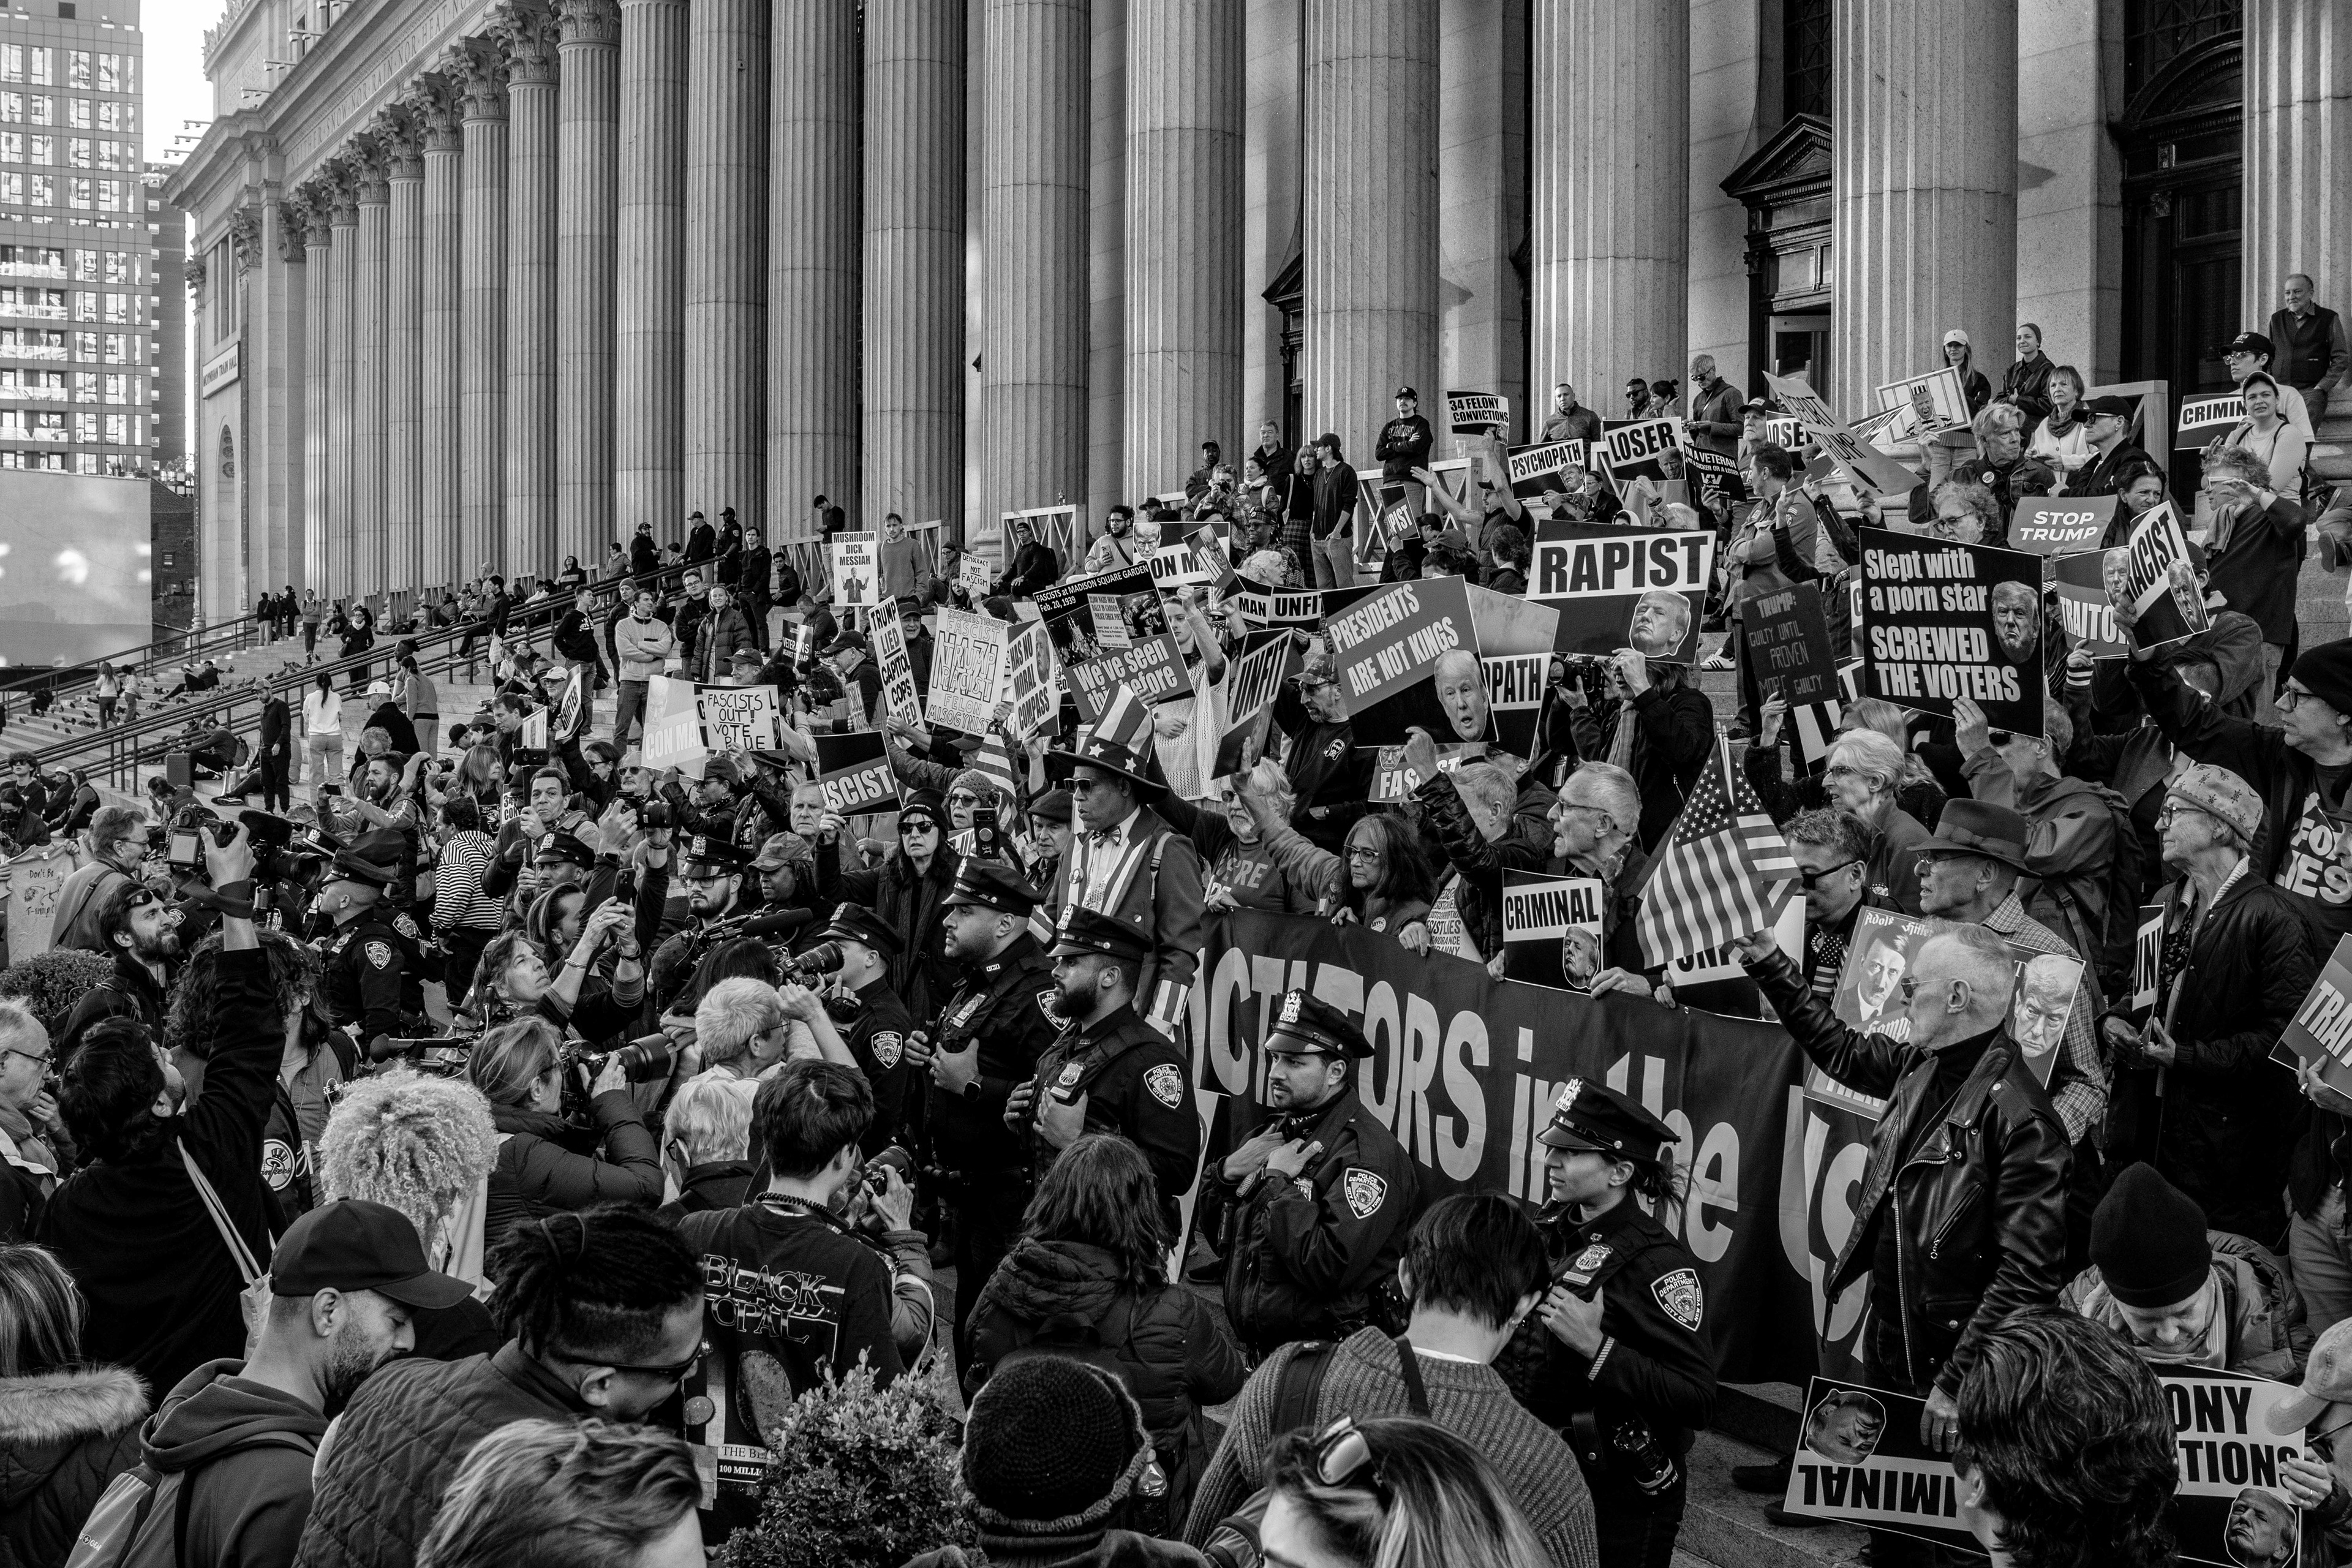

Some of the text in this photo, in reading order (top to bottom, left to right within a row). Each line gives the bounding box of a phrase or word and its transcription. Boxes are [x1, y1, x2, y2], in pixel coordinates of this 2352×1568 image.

[422, 4, 447, 45] HEAT
[1449, 397, 1499, 411] 34 FELONY
[2182, 401, 2248, 425] CRIMIN
[1453, 410, 1509, 423] CONVICTIONS
[1608, 422, 1676, 462] LOSER
[1768, 421, 1807, 448] LOSE
[1809, 431, 1866, 465] TRUMP
[1512, 442, 1582, 478] PSYCHOPATH
[1696, 462, 1712, 471] SUCKER
[1725, 467, 1739, 476] LOSER
[1699, 452, 1736, 469] VETERAN
[2032, 511, 2095, 526] STOP
[833, 532, 875, 543] MUSHROOM
[2019, 526, 2098, 541] TRUMP
[839, 555, 871, 566] MESSIAH
[846, 544, 863, 554] DICK
[962, 554, 989, 567] DEMOCRACY
[1539, 536, 1708, 595] RAPIST
[1865, 548, 1975, 581] Slept with
[962, 573, 988, 587] FASCISM
[1036, 564, 1149, 603] FASCISTS at MADISON SQUARE GARDEN
[1039, 595, 1076, 612] Feb. 20, 1939
[1238, 596, 1267, 617] MAN
[1869, 586, 1884, 611] a
[1887, 586, 1939, 614] porn
[1942, 583, 1988, 611] star
[870, 601, 896, 631] TRUMP
[948, 609, 1006, 630] INSURRECTIONIST
[1329, 584, 1420, 654] PRESIDENTS
[880, 627, 900, 655] LIED
[946, 617, 1000, 643] FASCIST
[1748, 620, 1804, 647] GUILTY UNTIL
[782, 648, 794, 659] AGAINST
[794, 652, 809, 663] TRUMP
[783, 636, 810, 655] VETERANS
[1011, 631, 1033, 673] HAS NO
[1770, 641, 1809, 670] PROVEN
[1871, 626, 1989, 662] SCREWED
[943, 641, 997, 676] TRUMP
[1073, 657, 1126, 692] We've
[1123, 638, 1170, 673] seen
[1347, 616, 1460, 697] ARE NOT KINGS
[881, 651, 911, 687] CAPITOL
[1231, 630, 1291, 725] UNFIT
[891, 677, 913, 707] COPS
[940, 665, 992, 698] RACIST
[1014, 663, 1037, 703] MORAL
[1793, 674, 1823, 695] GUILTY
[1874, 663, 1921, 697] THE
[1921, 664, 2021, 702] VOTERS
[560, 684, 579, 731] GRIFTER
[707, 693, 763, 711] FASCISTS
[943, 693, 982, 716] FELON
[1017, 686, 1050, 732] COMPASS
[719, 709, 755, 724] OUT!
[927, 704, 993, 734] MISOGYNIST
[713, 723, 751, 737] VOTE
[646, 727, 673, 761] CON
[29, 869, 45, 878] Don't
[1505, 886, 1600, 932] CRIMINAL
[1864, 911, 1895, 927] Adolf
[1148, 1071, 1178, 1084] DEPARTMENT
[1153, 1066, 1170, 1075] POLICE
[1153, 1088, 1163, 1098] CITY
[1349, 1177, 1382, 1194] DEPARTMENT
[1357, 1172, 1378, 1184] POLICE
[1363, 1206, 1373, 1215] NEW
[1371, 1196, 1381, 1208] YORK
[704, 1253, 826, 1308] BLACK
[1659, 1278, 1695, 1298] DEPARTMENT
[1664, 1273, 1687, 1286] POLICE
[711, 1296, 810, 1344] OPAL
[1664, 1303, 1678, 1317] CITY
[1678, 1315, 1687, 1324] OF
[722, 1446, 746, 1457] THE
[719, 1464, 760, 1476] 100 MILLI
